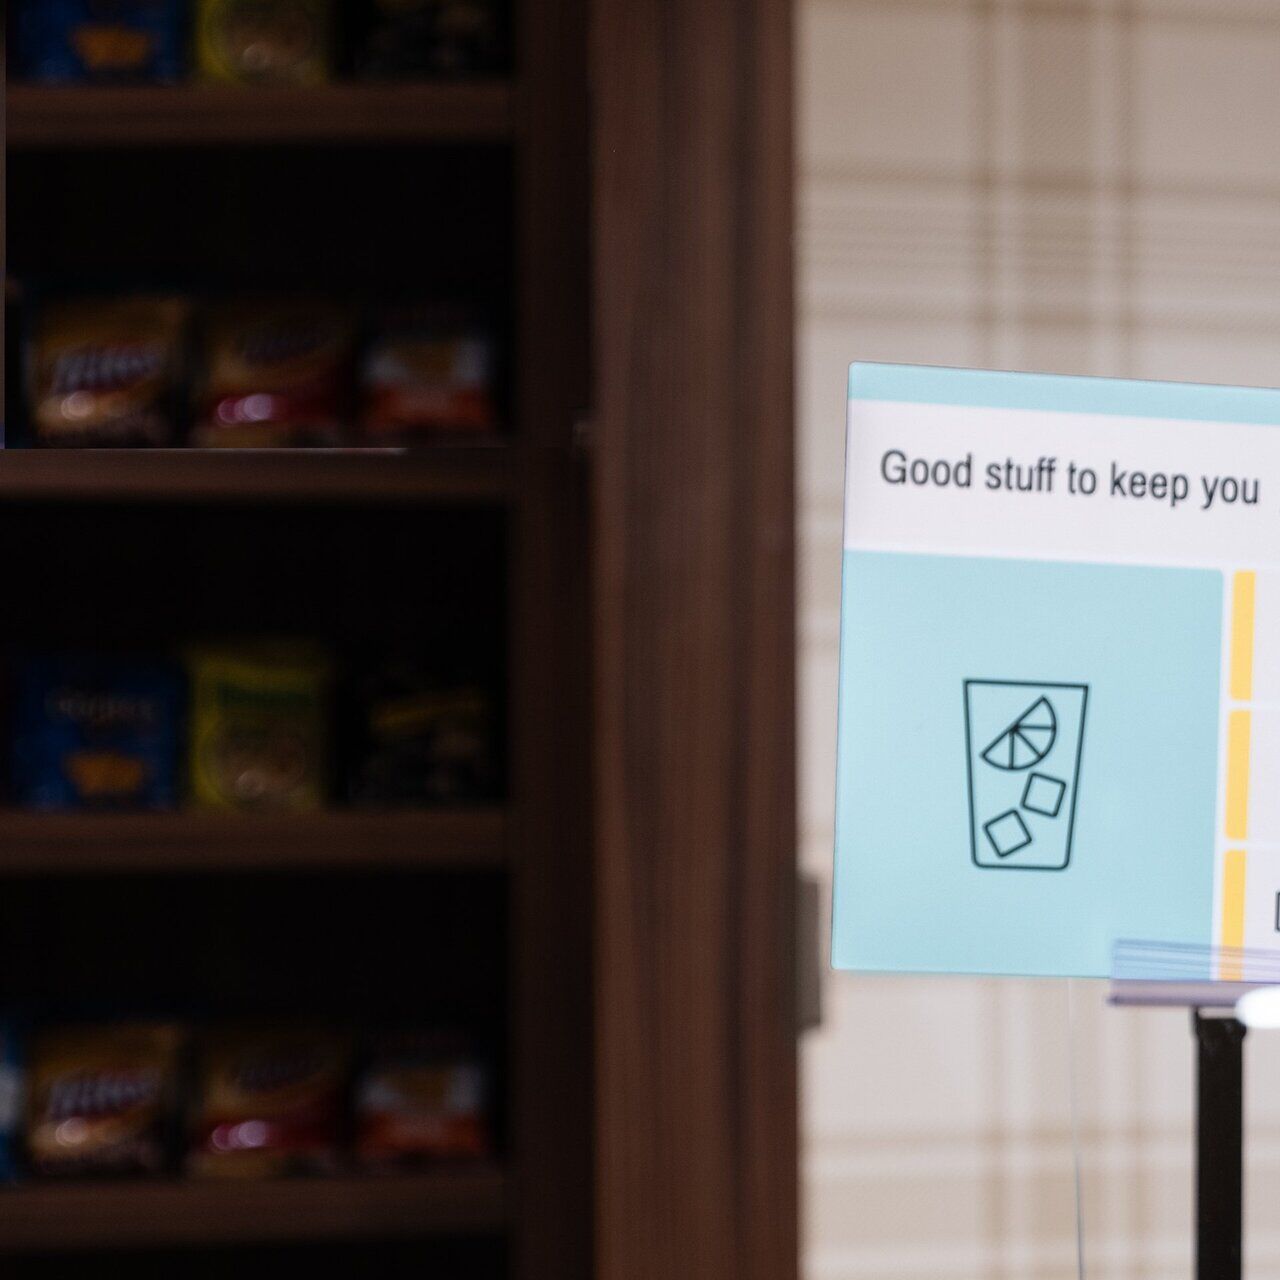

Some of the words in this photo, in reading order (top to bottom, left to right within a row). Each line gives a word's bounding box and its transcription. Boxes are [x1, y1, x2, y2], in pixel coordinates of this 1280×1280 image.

[880, 448, 972, 489] Good
[984, 456, 1056, 493] stuff
[1067, 461, 1098, 496] to
[1109, 461, 1189, 507] keep
[1201, 476, 1260, 511] you
